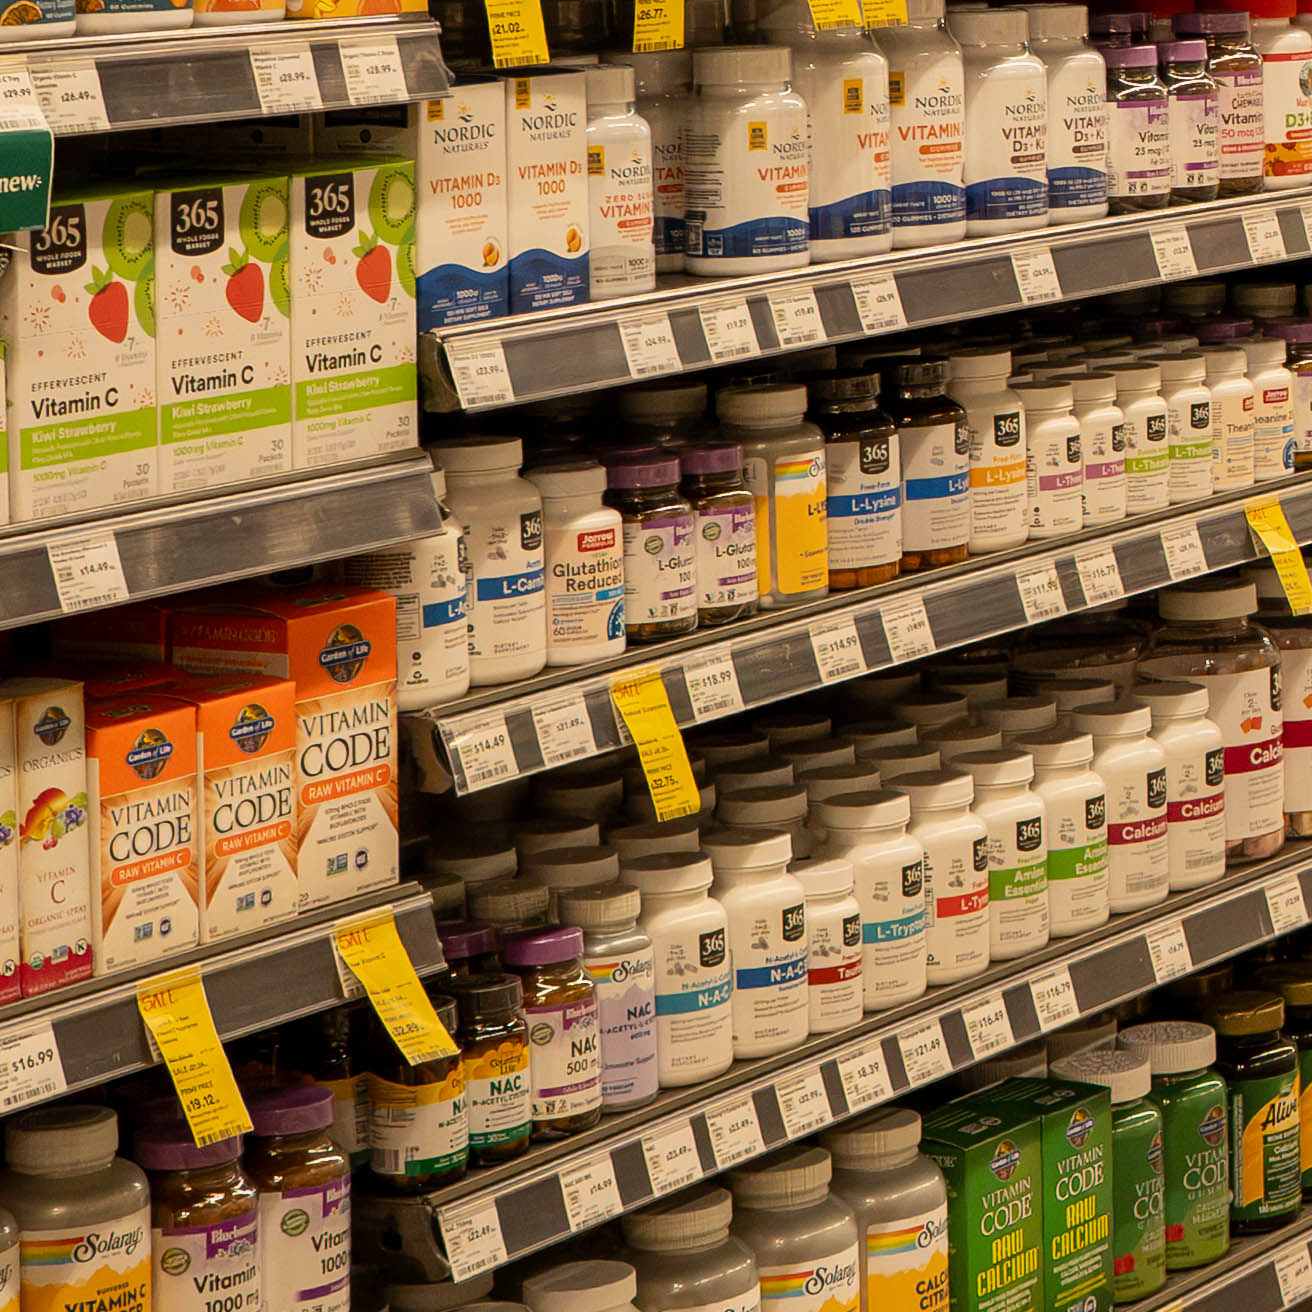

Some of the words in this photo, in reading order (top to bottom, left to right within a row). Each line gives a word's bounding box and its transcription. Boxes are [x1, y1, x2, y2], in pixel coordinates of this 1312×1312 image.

[521, 111, 578, 132] NORDIC
[898, 125, 961, 142] VITAMIN
[434, 123, 496, 146] NORDIC
[529, 128, 573, 143] NATURALS
[443, 141, 490, 155] NATURALS
[430, 173, 484, 195] VITAMIN
[518, 162, 568, 181] VITAMIN
[310, 182, 352, 217] 365
[537, 179, 566, 196] 1000
[451, 193, 482, 209] 1000
[175, 198, 220, 233] 365
[35, 216, 82, 253] 365
[305, 329, 373, 349] EFFERVESCENT
[171, 349, 244, 371] EFFERVESCENT
[305, 346, 367, 374] Vitamin
[369, 343, 384, 365] C
[31, 371, 108, 394] EFFERVESCENT
[171, 370, 238, 396] Vitamin
[241, 364, 256, 385] C
[31, 391, 102, 421] Vitamin
[104, 387, 120, 408] C
[31, 427, 57, 443] Kiwi
[57, 418, 118, 441] Strawberry
[135, 462, 150, 477] 30
[852, 495, 898, 513] L-Lysine
[565, 572, 622, 593] Reduced
[301, 699, 391, 739] VITAMIN
[22, 747, 84, 776] ORGANICS
[300, 725, 392, 779] CODE
[213, 764, 292, 798] VITAMIN
[308, 784, 332, 801] RAW
[333, 774, 374, 795] VITAMIN
[110, 790, 191, 828] VITAMIN
[213, 788, 292, 835] CODE
[1181, 799, 1224, 818] Calcium
[109, 814, 192, 863] CODE
[1019, 823, 1041, 842] 365
[1122, 822, 1168, 841] Calcium
[702, 932, 726, 957] 365
[626, 1002, 652, 1022] NAC
[12, 1048, 54, 1073] $16.99
[566, 1060, 589, 1076] 500
[489, 1075, 523, 1097] NAC
[1056, 1143, 1104, 1177] VITAMIN
[1055, 1160, 1105, 1202] CODE
[980, 1193, 1034, 1237] CODE
[72, 1226, 144, 1263] Solaray
[1052, 1213, 1110, 1261] CALCIUM
[977, 1246, 1039, 1298] CALCIUM
